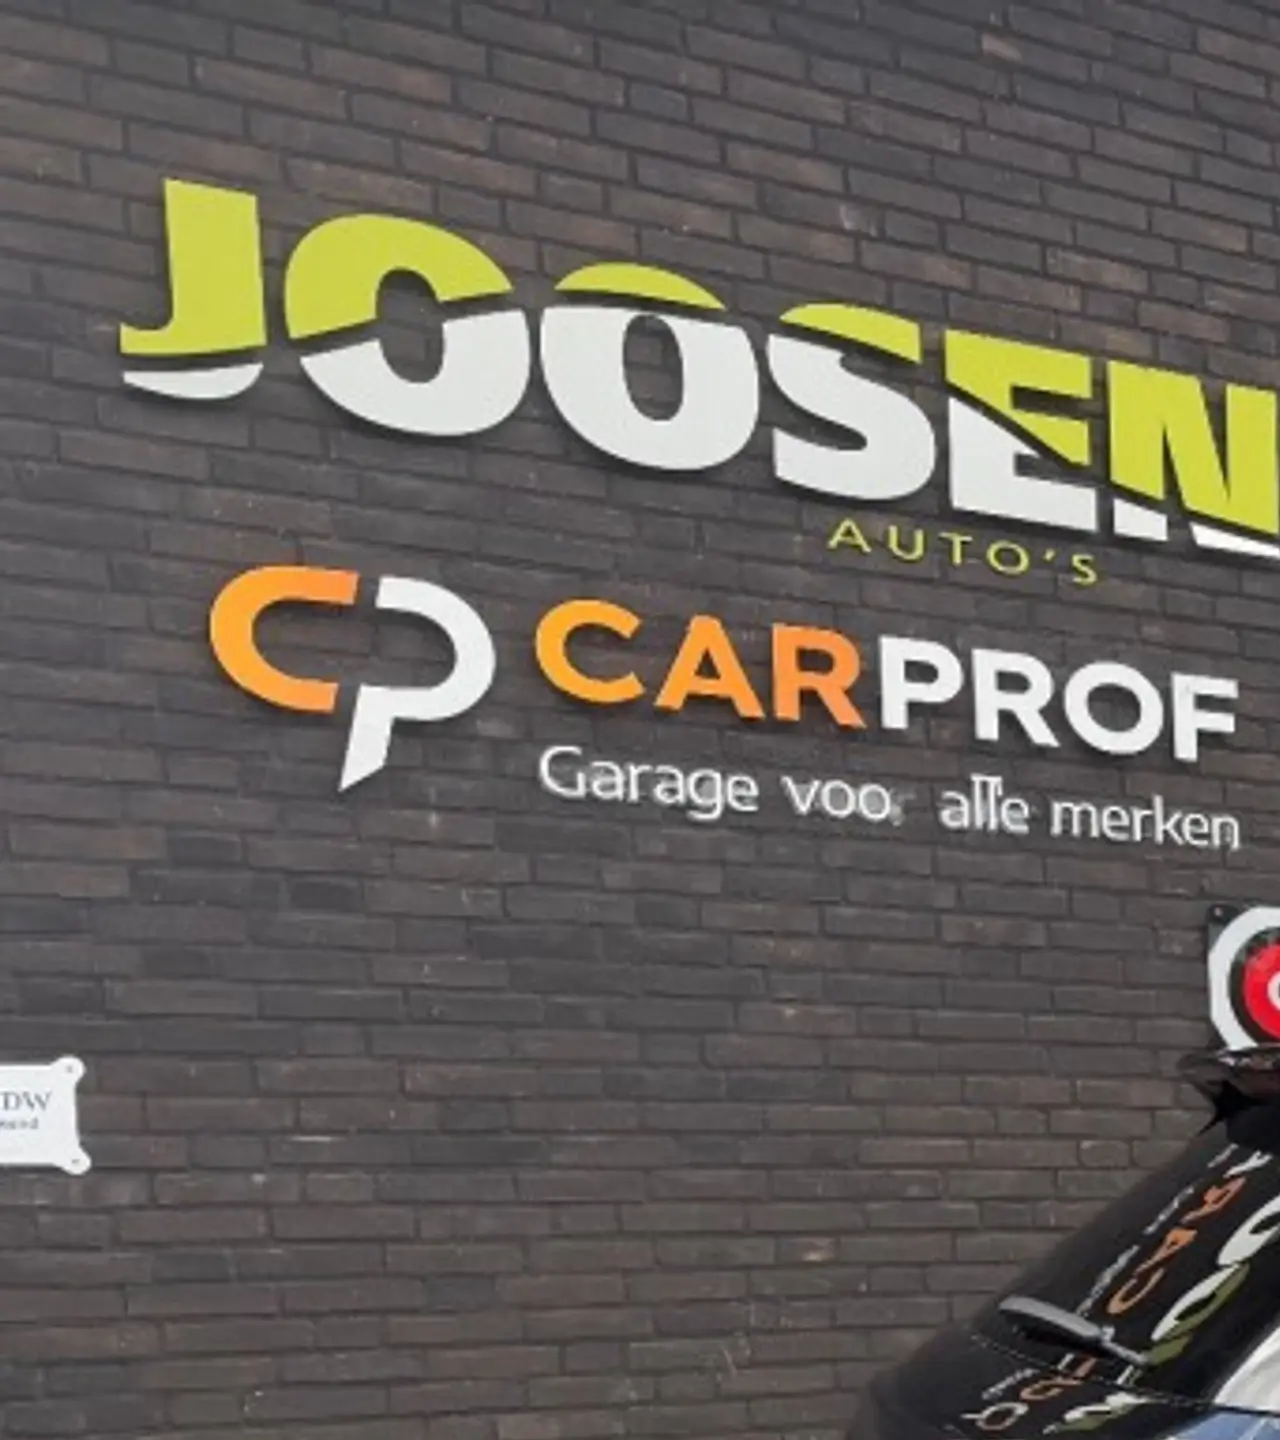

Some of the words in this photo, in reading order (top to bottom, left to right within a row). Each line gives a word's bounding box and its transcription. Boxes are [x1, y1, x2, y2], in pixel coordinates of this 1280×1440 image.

[828, 517, 1099, 586] AUTO'S
[533, 598, 1239, 764] CARPROF
[539, 744, 760, 820] Garage
[938, 772, 1031, 835] alle
[1050, 793, 1240, 851] merken
